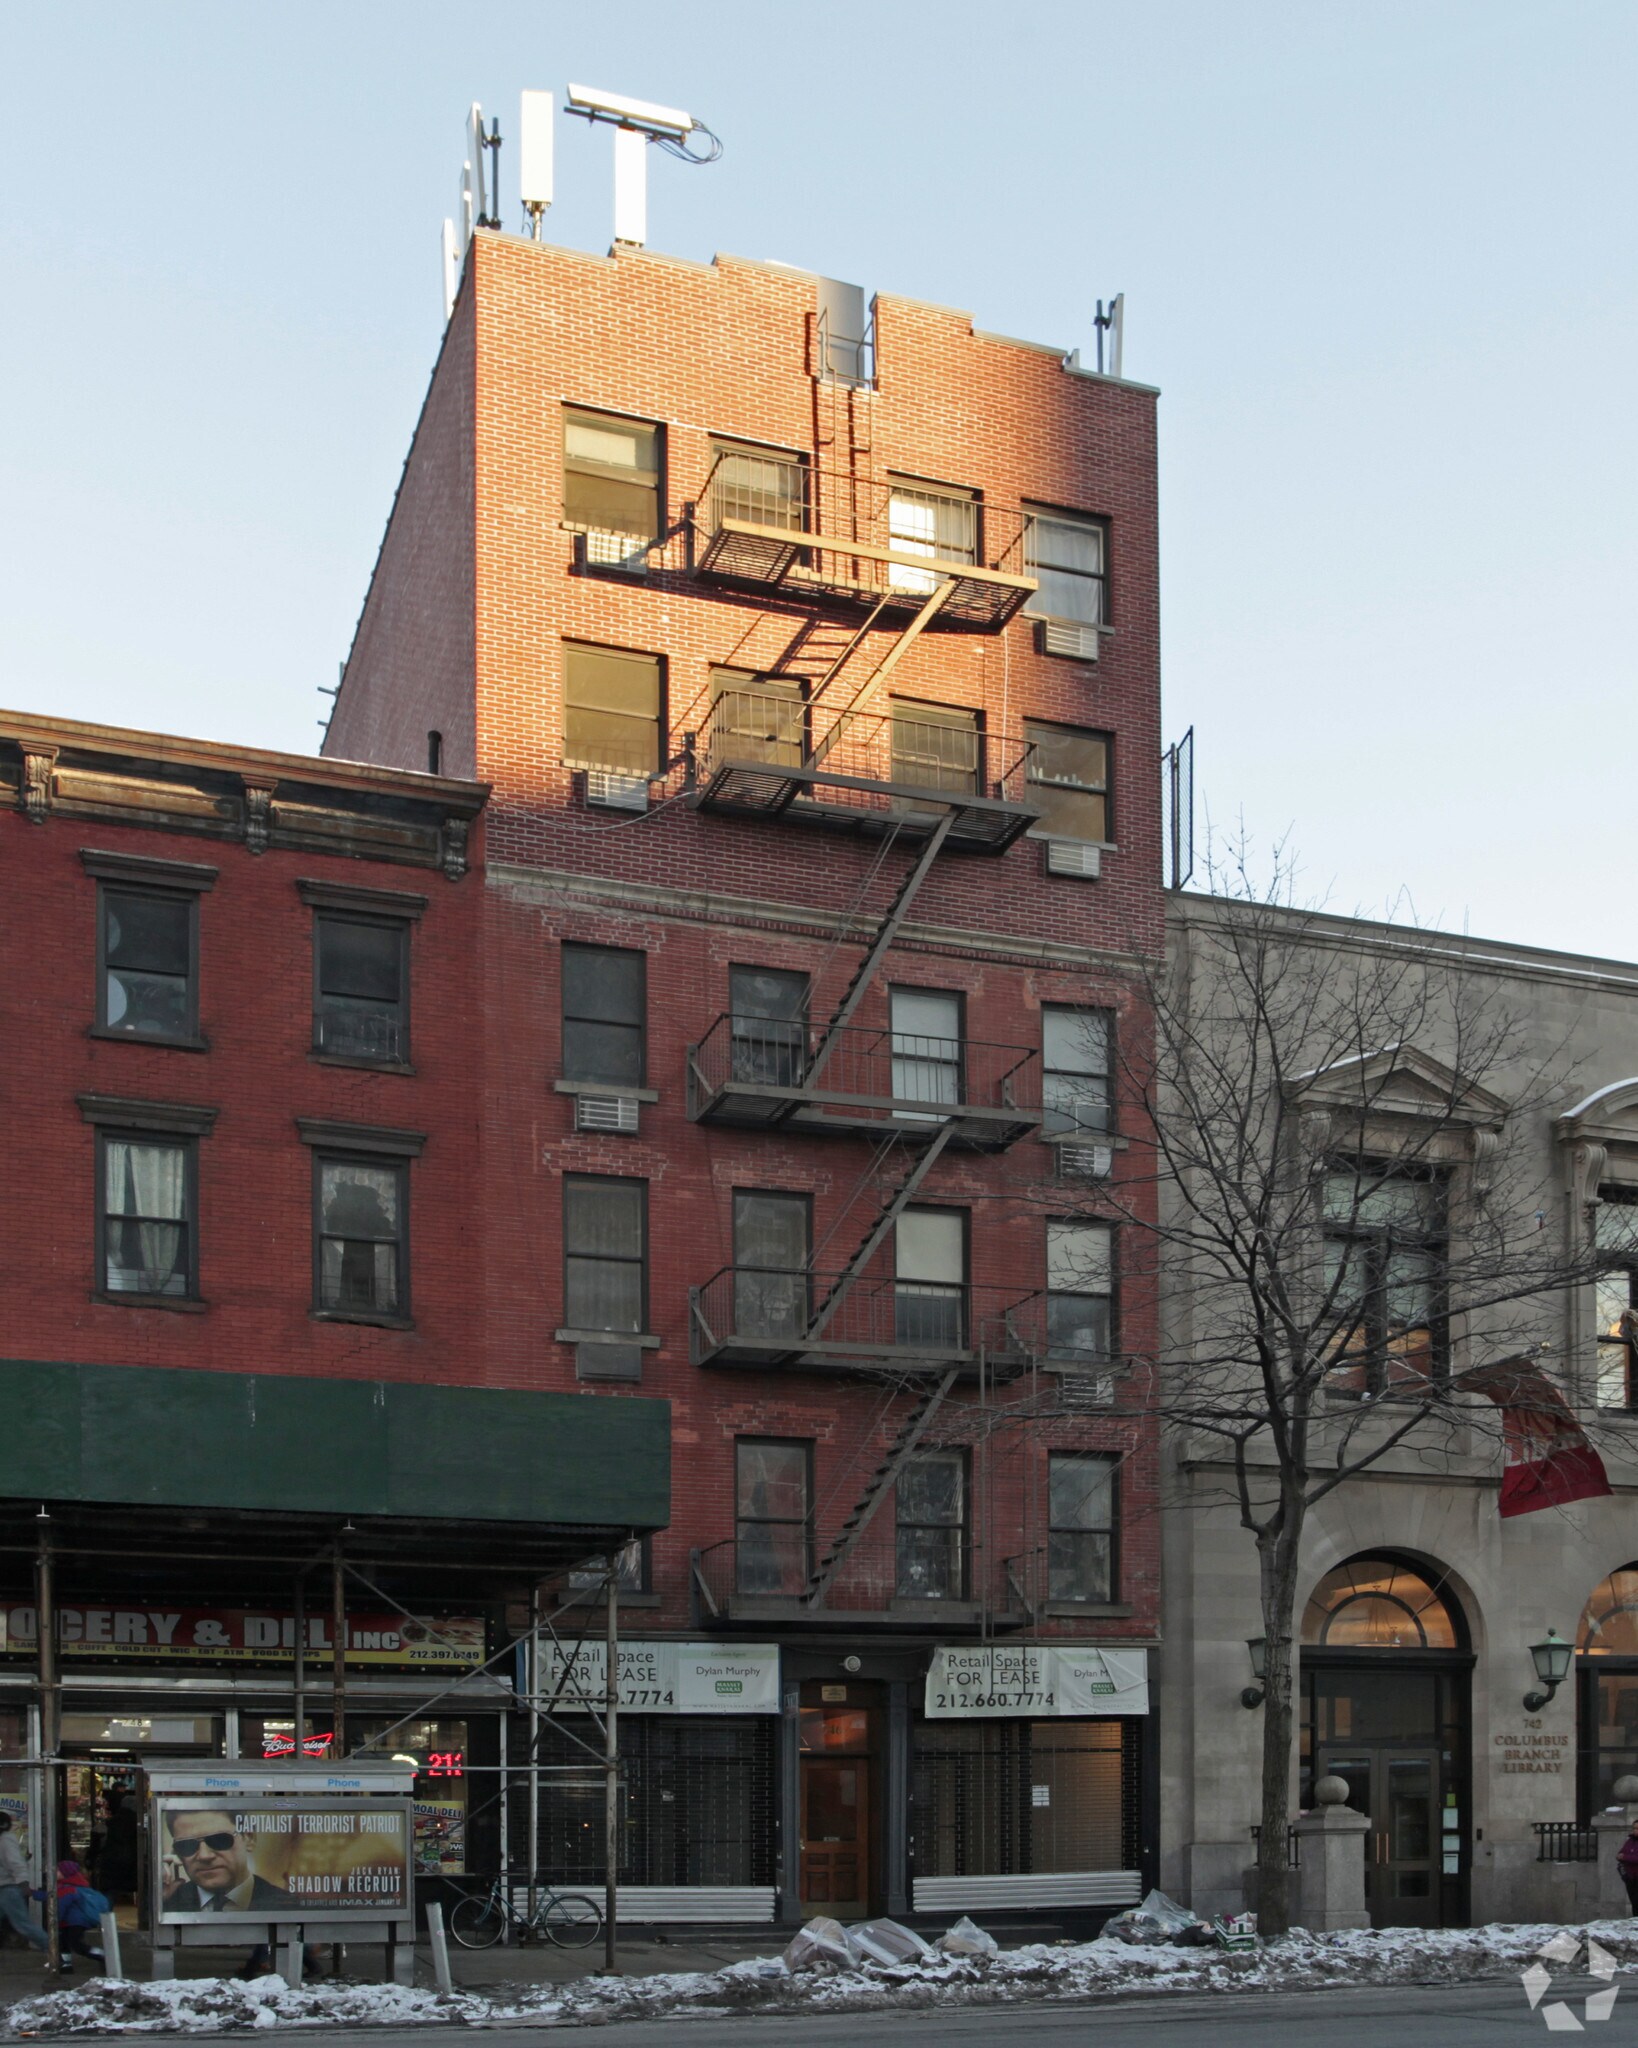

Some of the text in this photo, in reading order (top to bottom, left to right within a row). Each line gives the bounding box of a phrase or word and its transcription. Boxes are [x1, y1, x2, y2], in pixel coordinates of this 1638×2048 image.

[193, 1619, 231, 1647] &
[353, 1631, 400, 1649] INC
[281, 1650, 320, 1658] STMPS
[553, 1647, 655, 1666] Retail pace
[948, 1654, 1038, 1671] Retail Space
[551, 1666, 591, 1681] FOR
[696, 1666, 761, 1677] Dylan Murphy
[1074, 1669, 1098, 1679] Dylan
[947, 1671, 1040, 1685] FOR LEASE
[936, 1693, 1054, 1709] 212.660.7774
[261, 1739, 331, 1752] Budeiser
[1494, 1735, 1569, 1747] COLUMBUS
[1504, 1749, 1561, 1760] BRANCH
[1503, 1762, 1562, 1774] LIBRARY
[205, 1778, 240, 1788] Phone
[327, 1778, 361, 1788] Phone
[235, 1814, 401, 1833] CAPITALIST TERRORIST PATRIOT
[350, 1866, 373, 1875] JACK
[288, 1875, 401, 1893] SHADOW RECRUIT
